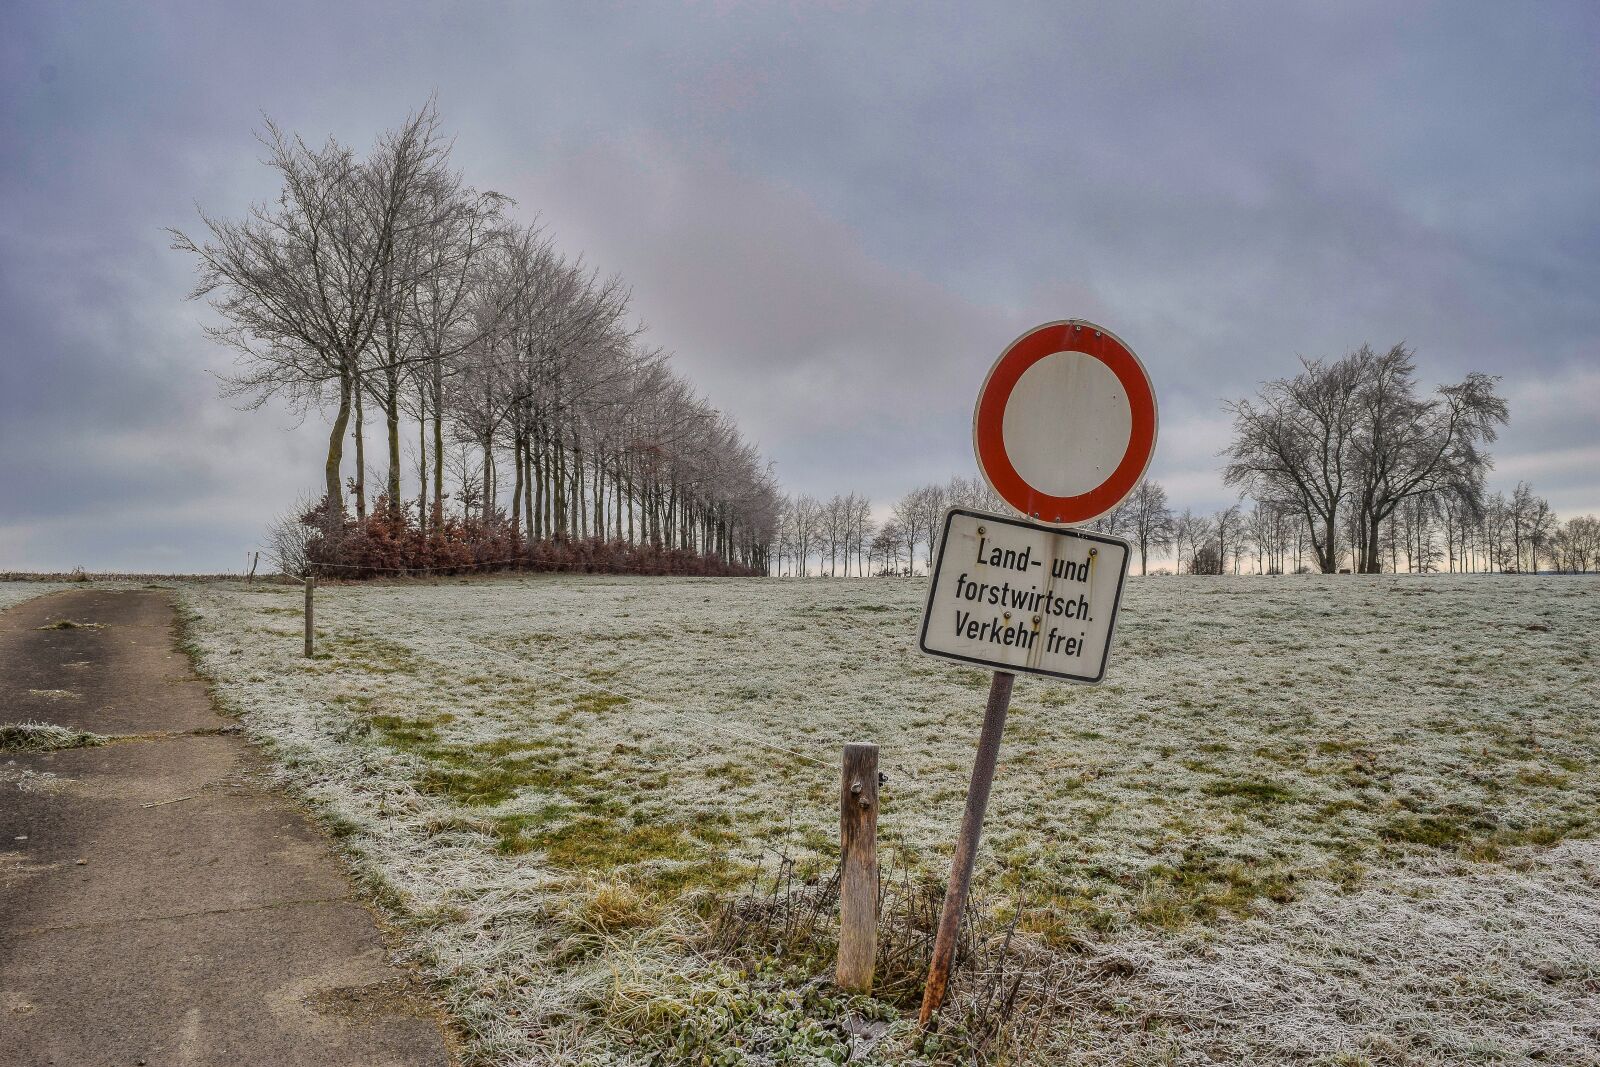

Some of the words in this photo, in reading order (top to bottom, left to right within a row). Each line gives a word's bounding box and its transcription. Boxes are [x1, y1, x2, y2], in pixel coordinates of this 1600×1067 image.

[977, 538, 1042, 572] Land-
[1052, 557, 1091, 583] und
[955, 573, 1093, 621] forstwirtsch.
[955, 610, 1040, 649] Verkehr
[1047, 627, 1085, 657] frei
